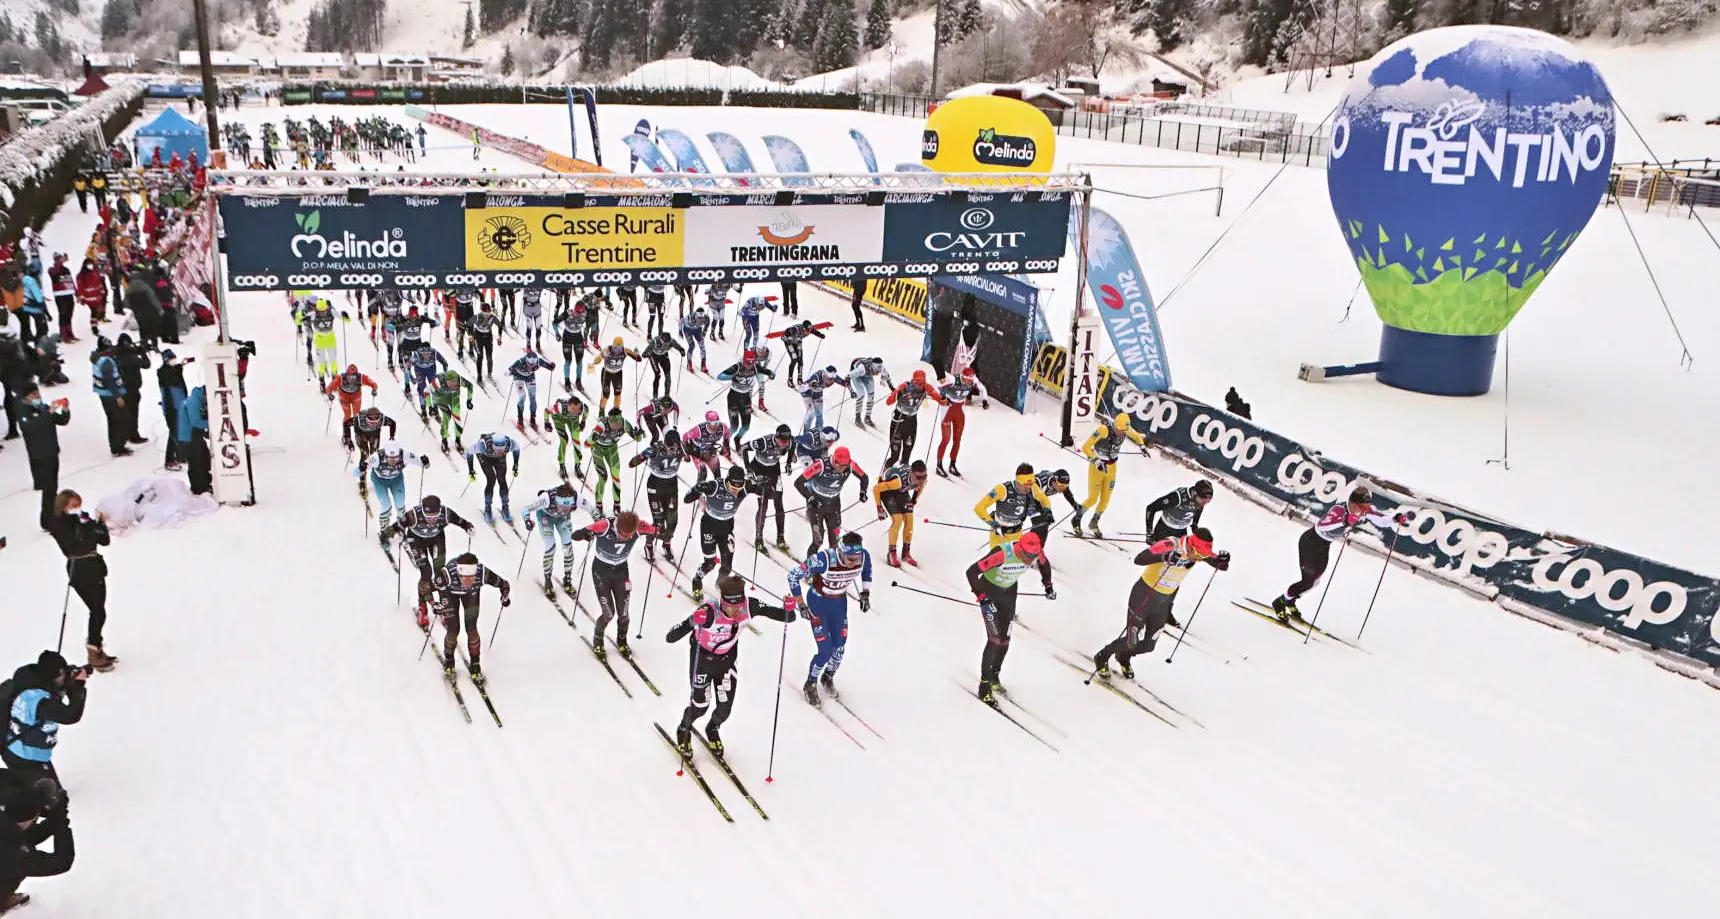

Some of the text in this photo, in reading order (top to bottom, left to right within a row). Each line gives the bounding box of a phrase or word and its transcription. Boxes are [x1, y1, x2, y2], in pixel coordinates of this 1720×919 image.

[1381, 111, 1606, 188] TRENTINO
[243, 197, 279, 208] TRENTINO
[405, 197, 439, 207] TRENTINO
[700, 197, 730, 206] TRENTINO
[834, 195, 863, 204] TRENTINO
[968, 194, 994, 203] TRENTINO
[542, 213, 675, 236] Casse Rurali
[924, 232, 1026, 252] CAVIT
[561, 242, 656, 264] Trentine
[731, 245, 840, 262] TRENTINGRANA
[235, 260, 1057, 288] coop coop coop coop coop coop coop coop coop coop coop coop coop coop coop coop coop coop
[327, 262, 349, 271] MELA
[350, 262, 366, 271] VAL
[368, 262, 376, 270] DI
[378, 261, 399, 270] NON
[1077, 331, 1094, 417] ITAS
[214, 363, 240, 469] ITAS
[723, 501, 735, 510] 5
[1014, 506, 1025, 516] 3
[1112, 384, 1178, 433] coop
[1190, 414, 1265, 472] coop
[1531, 553, 1688, 630] coop
[1183, 512, 1193, 520] 2
[614, 543, 626, 555] 7
